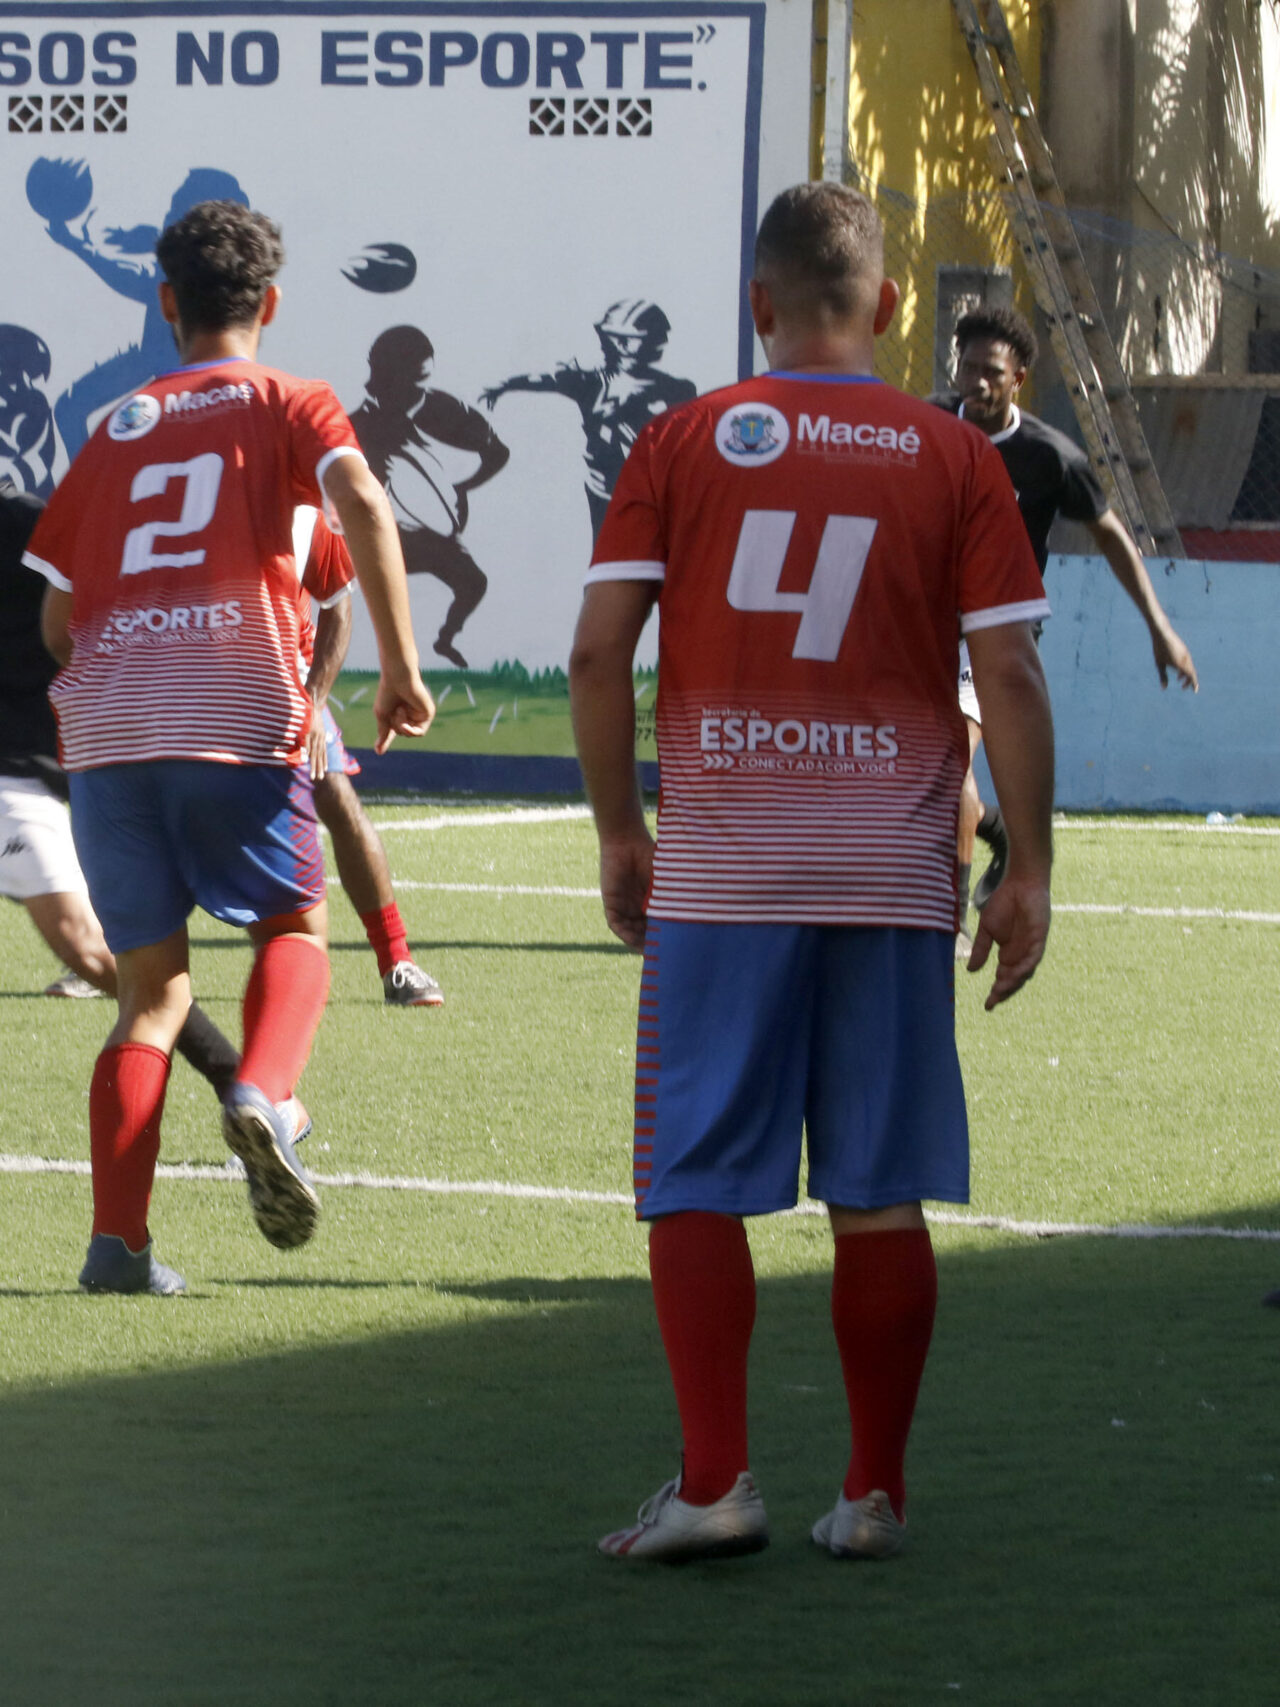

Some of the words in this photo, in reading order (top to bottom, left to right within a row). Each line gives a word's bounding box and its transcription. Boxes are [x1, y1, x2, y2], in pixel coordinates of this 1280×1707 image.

[175, 30, 280, 87] NO
[164, 380, 255, 414] Macaé
[796, 413, 920, 454] Macaé
[119, 452, 224, 577] 2
[726, 509, 878, 662] 4
[700, 716, 899, 759] ESPORTES
[827, 760, 855, 774] COM
